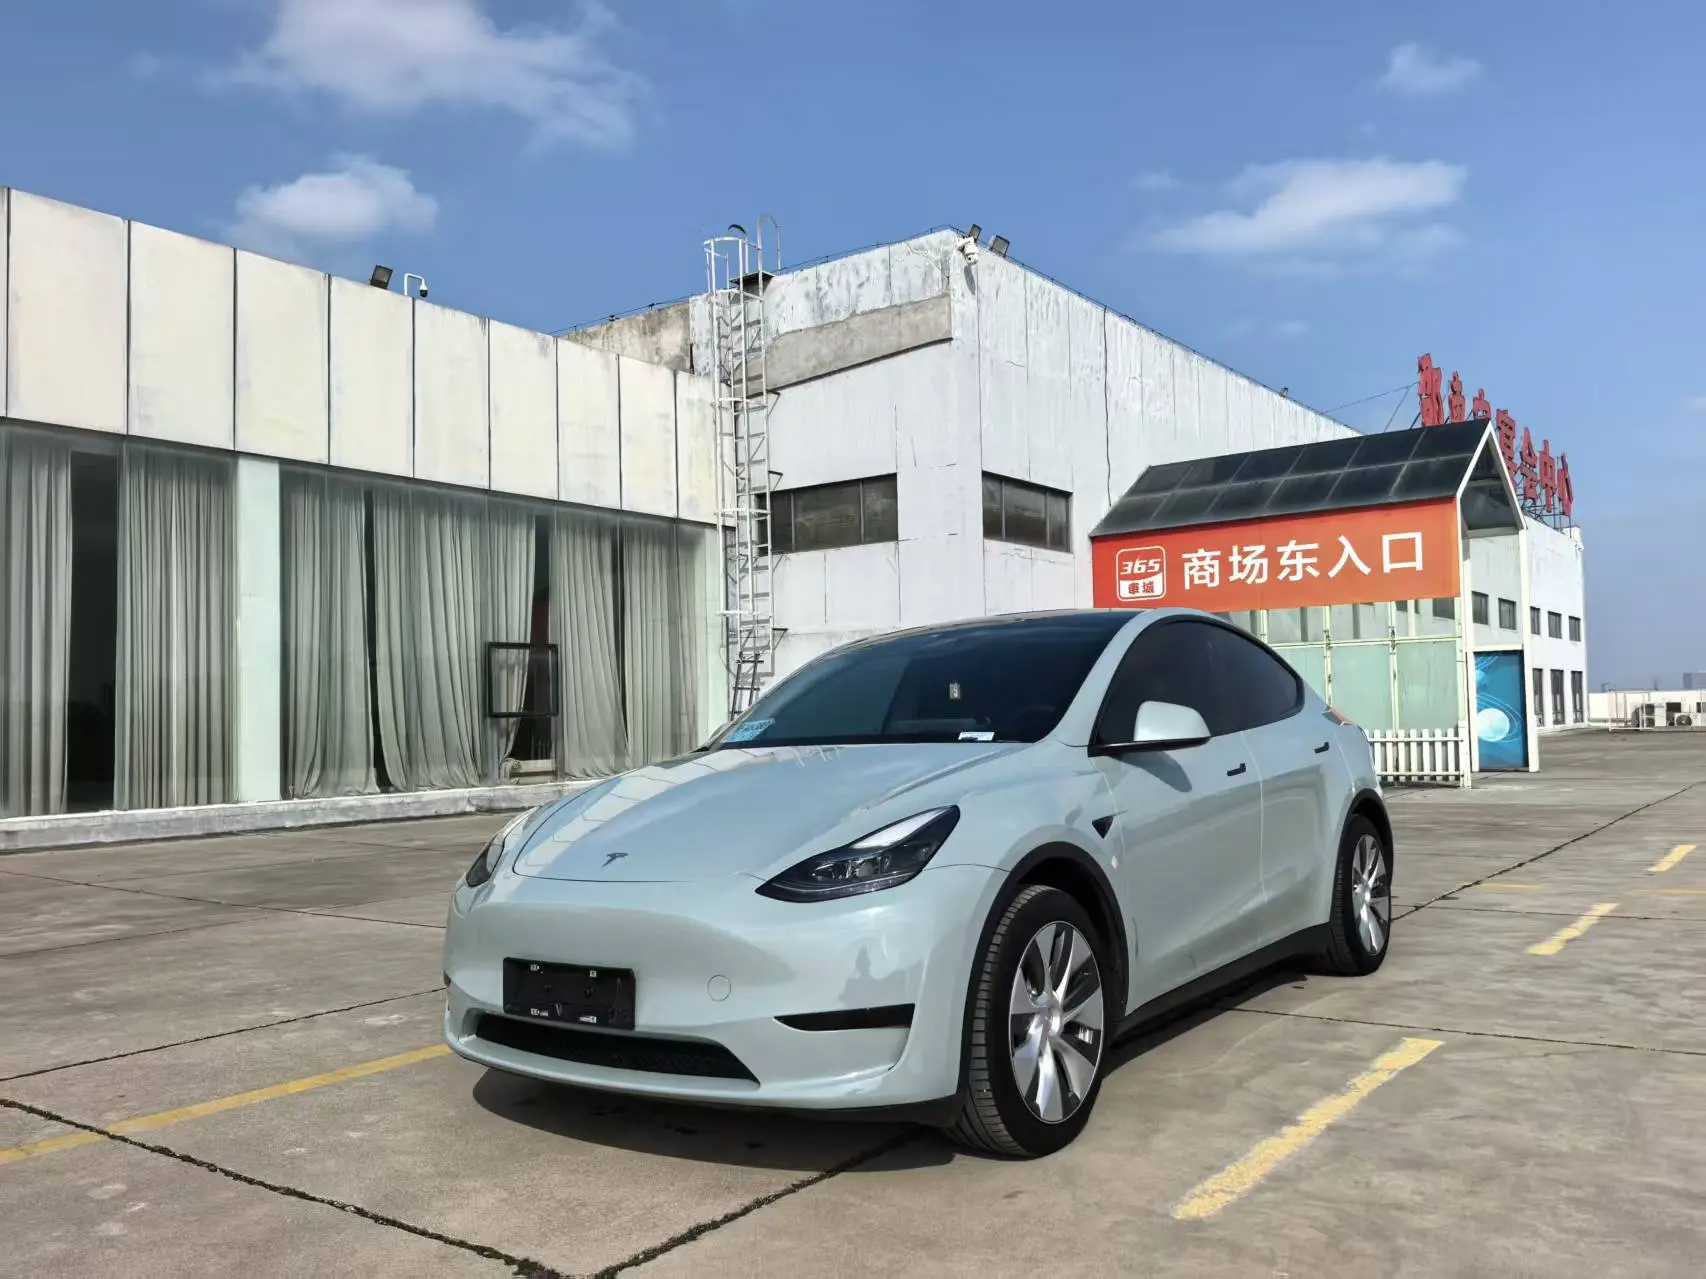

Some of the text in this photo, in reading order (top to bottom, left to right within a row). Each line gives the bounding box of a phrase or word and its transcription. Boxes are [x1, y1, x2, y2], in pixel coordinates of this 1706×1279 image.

[1119, 556, 1161, 576] 365
[1182, 531, 1424, 590] 商场东入口
